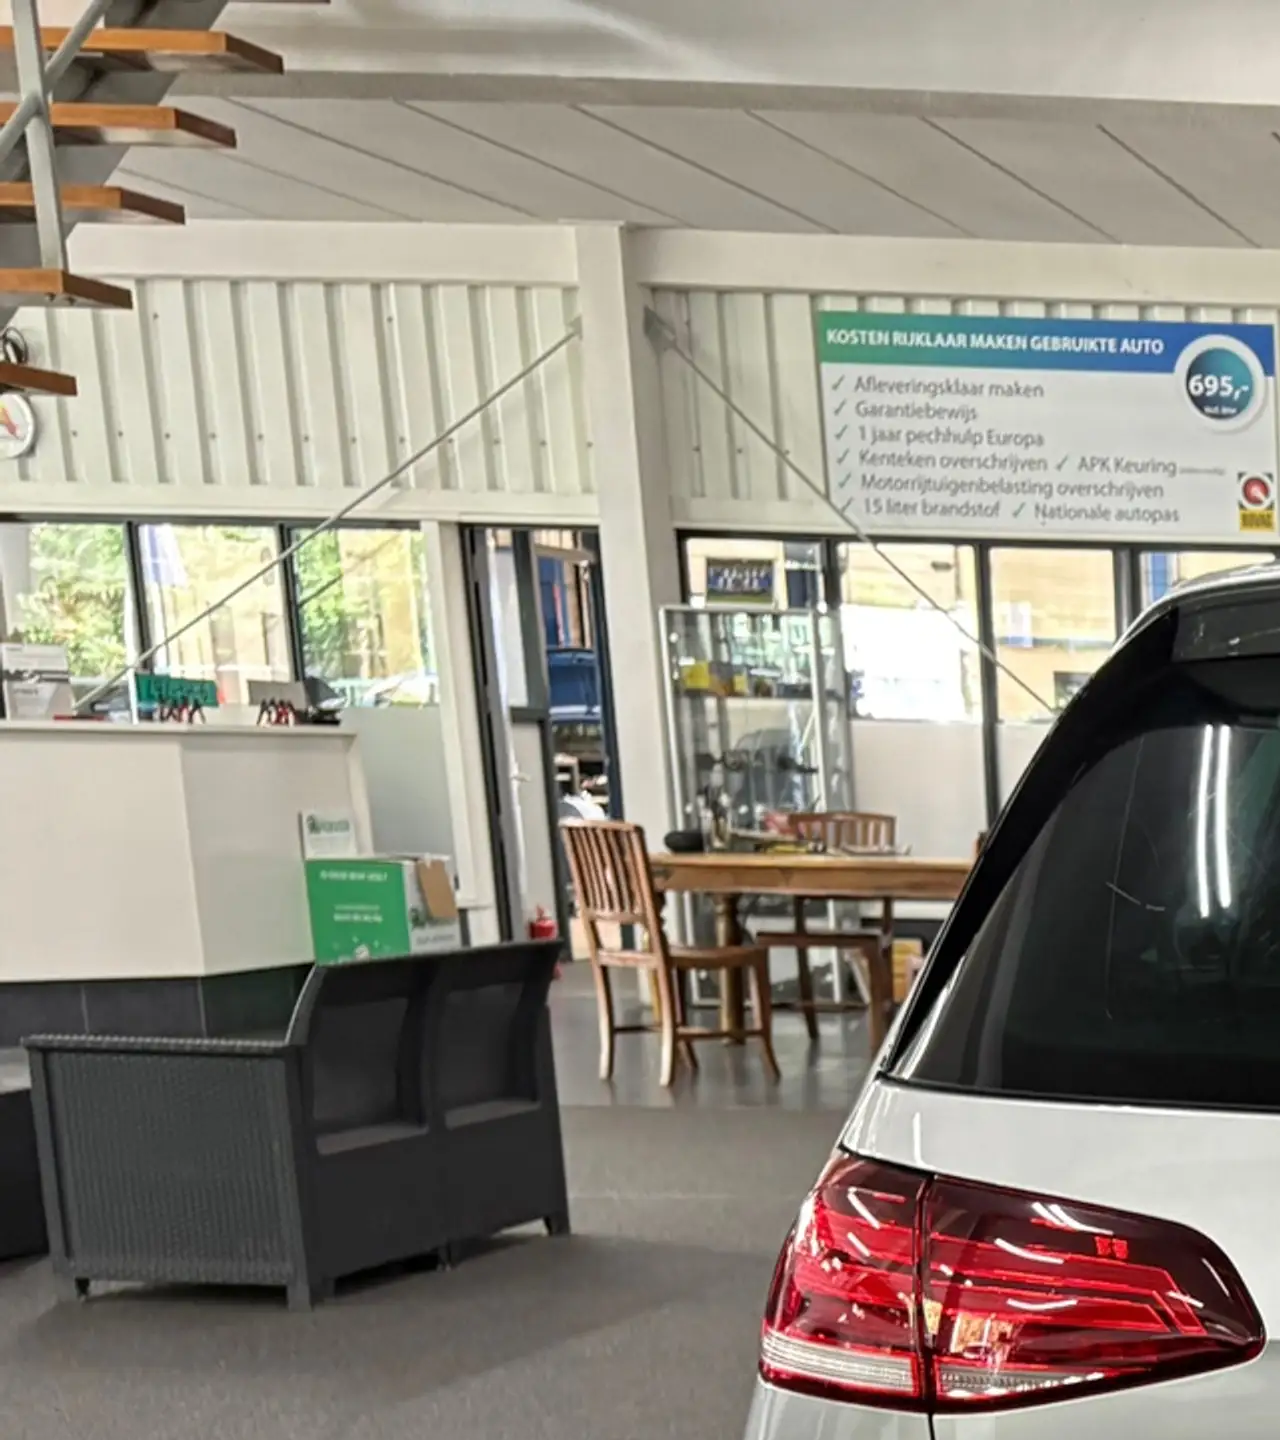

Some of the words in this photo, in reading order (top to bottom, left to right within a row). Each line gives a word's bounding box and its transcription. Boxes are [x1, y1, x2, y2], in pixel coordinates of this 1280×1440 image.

[825, 328, 889, 346] KOSTEN
[892, 330, 968, 348] RIJKLAAR
[970, 333, 1028, 350] MAKEN
[1030, 334, 1117, 353] GEBRUIKTE
[1120, 338, 1164, 355] AUTO
[854, 375, 984, 398] Afleveringsklaar
[988, 380, 1044, 398] maken
[1188, 372, 1249, 400] 695,-
[854, 400, 978, 424] Garantiebewijs
[858, 425, 866, 440] 1
[871, 427, 902, 445] jaar
[905, 427, 984, 449] pechhulp
[986, 429, 1045, 449] Europa
[858, 450, 936, 468] Kenteken
[939, 453, 1048, 473] overschrijven
[1077, 456, 1110, 472] APK
[1113, 457, 1178, 478] Keuring
[861, 473, 1053, 499] Motorrijtuigenbelasting
[1056, 480, 1164, 502] overschrijven
[864, 499, 883, 515] 15
[886, 499, 918, 515] liter
[921, 500, 1000, 518] brandstof
[1034, 503, 1111, 522] Nationale
[1114, 506, 1180, 525] autopas
